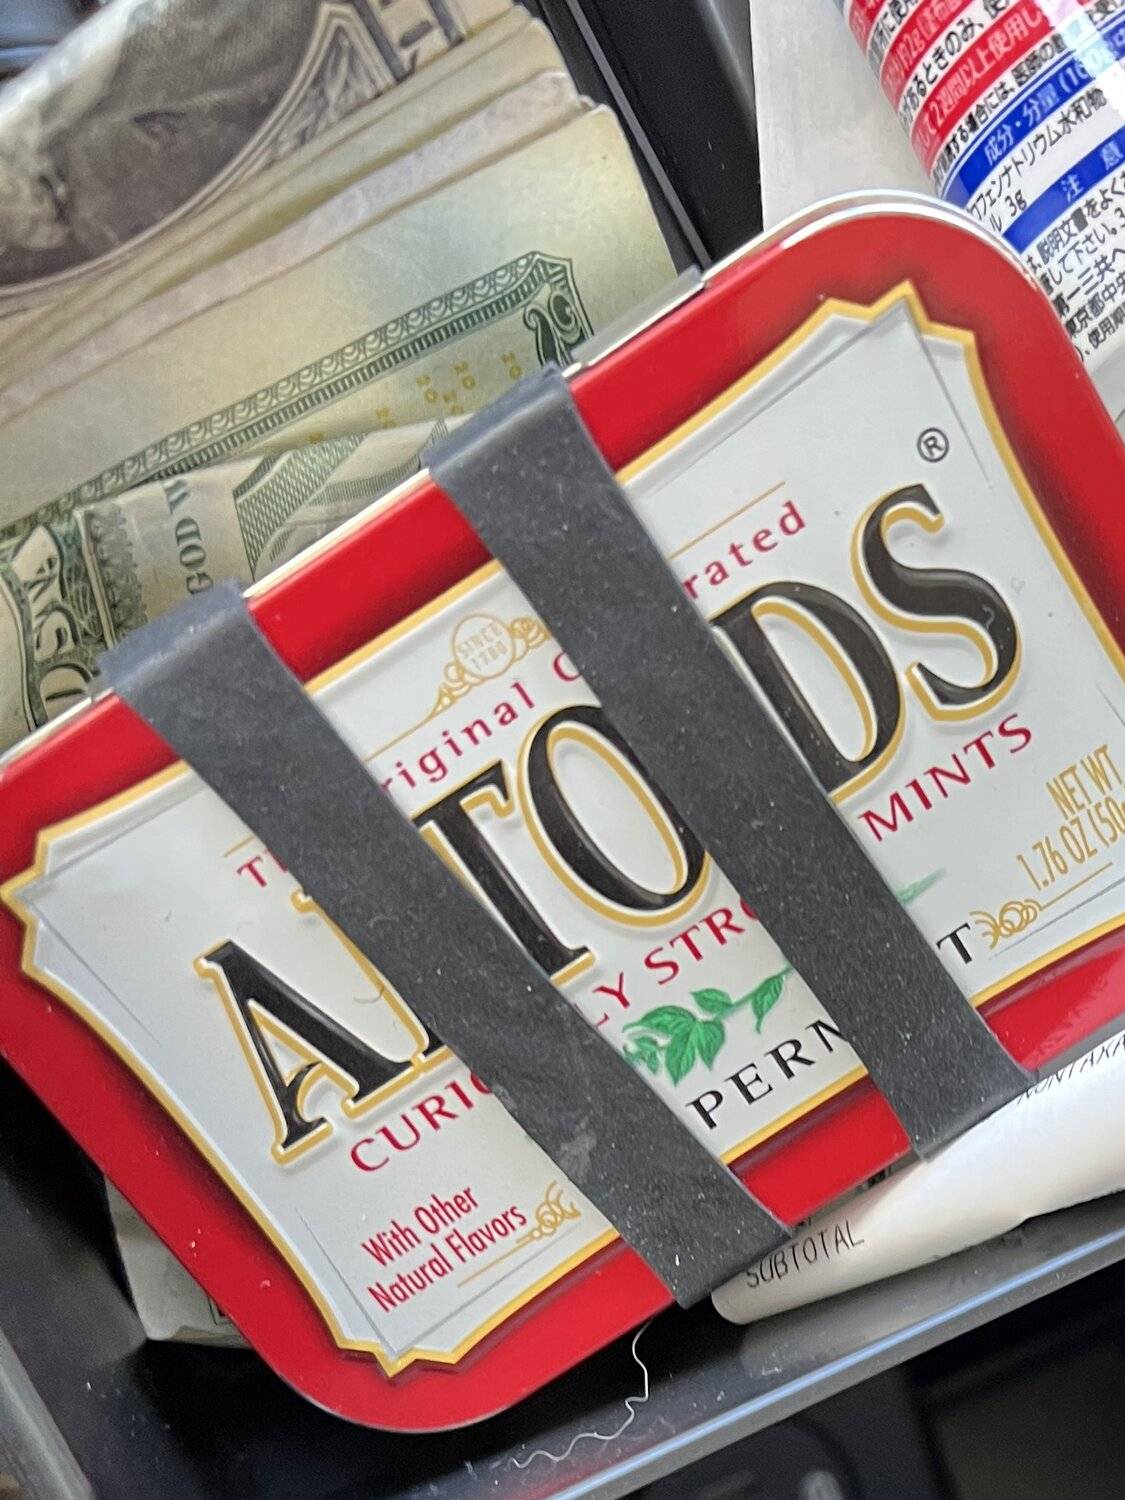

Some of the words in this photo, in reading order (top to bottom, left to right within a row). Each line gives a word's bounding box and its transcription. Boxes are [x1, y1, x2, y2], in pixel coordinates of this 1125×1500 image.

[175, 517, 215, 595] GOD
[380, 681, 536, 793] riginal
[857, 713, 1033, 843] MINTS
[1046, 764, 1093, 821] NET
[1080, 743, 1123, 796] WT
[1016, 836, 1069, 892] 1.76
[1059, 816, 1098, 865] OZ
[360, 1219, 418, 1268] With
[413, 1186, 480, 1239] Other
[367, 1250, 455, 1313] Natural
[450, 1203, 528, 1266] Flavors
[745, 1219, 865, 1289] SUBTOTAL
